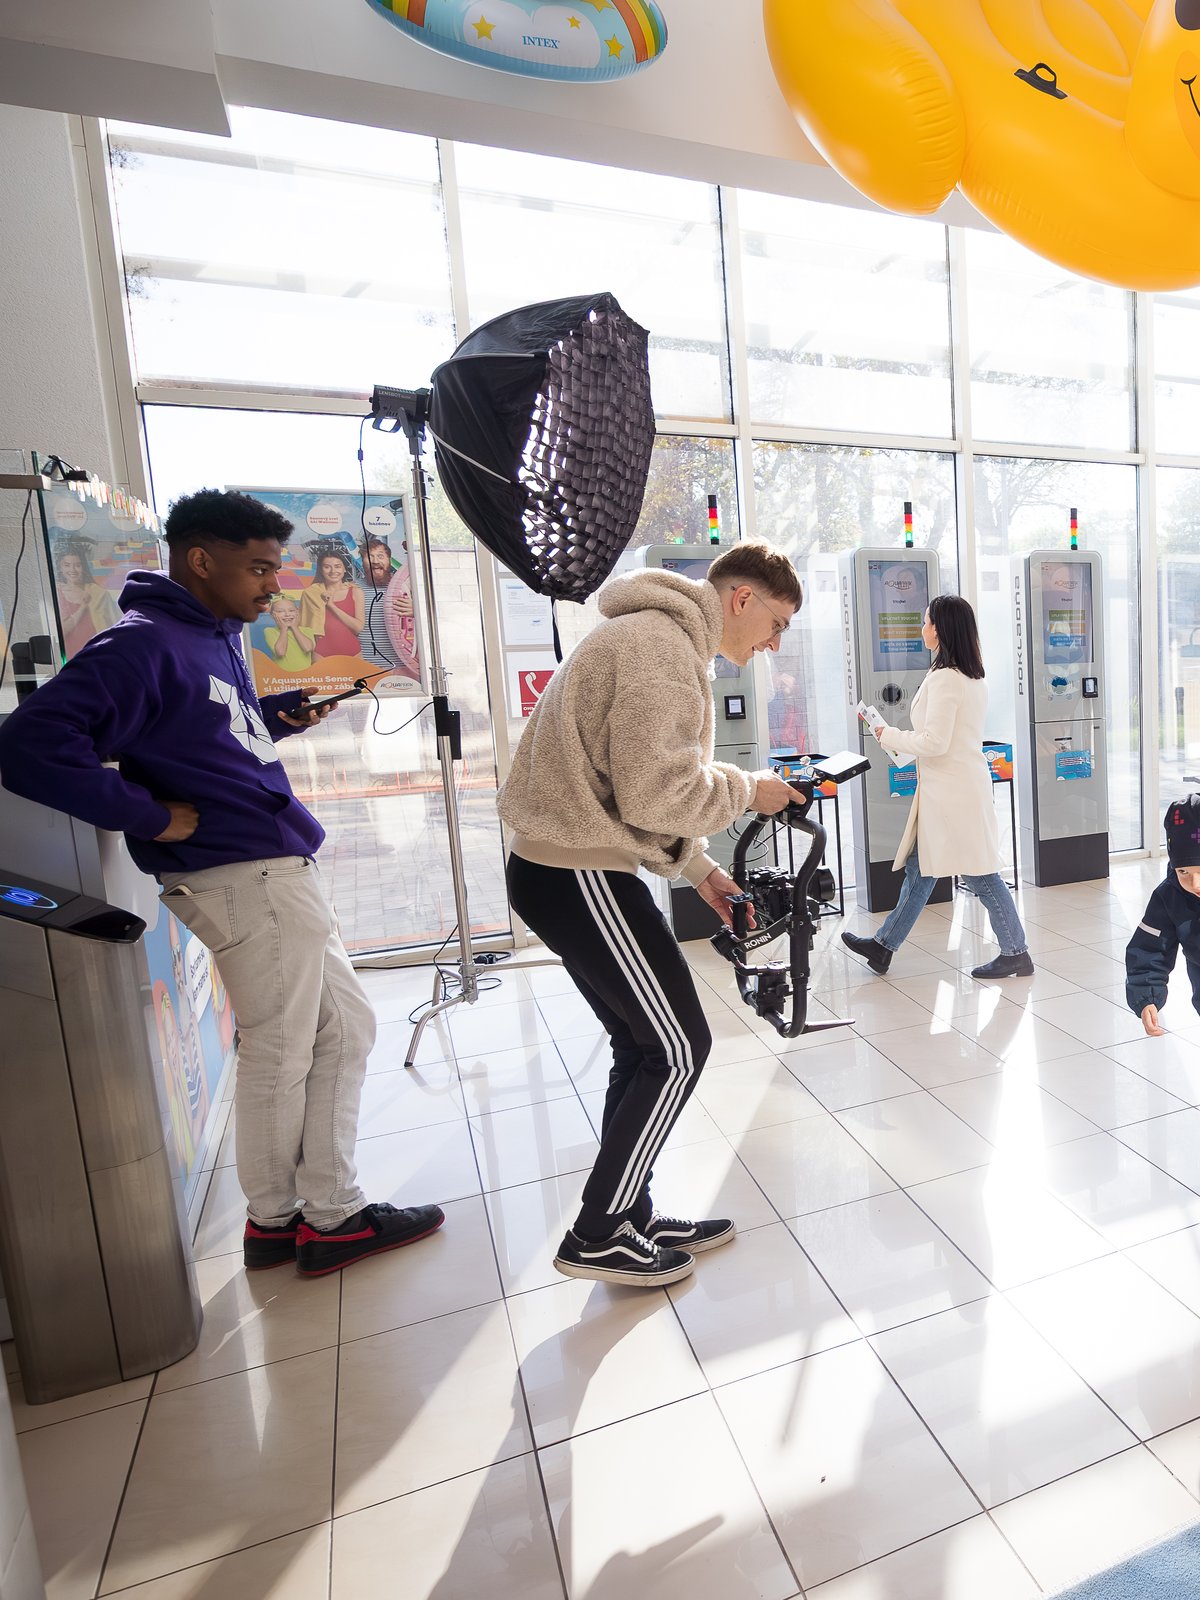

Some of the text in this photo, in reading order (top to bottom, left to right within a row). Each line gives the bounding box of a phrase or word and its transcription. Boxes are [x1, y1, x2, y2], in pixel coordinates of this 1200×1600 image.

[522, 36, 559, 49] INTEX
[271, 676, 323, 685] Aquaparku
[335, 682, 356, 690] záb
[744, 932, 772, 949] RONIN
